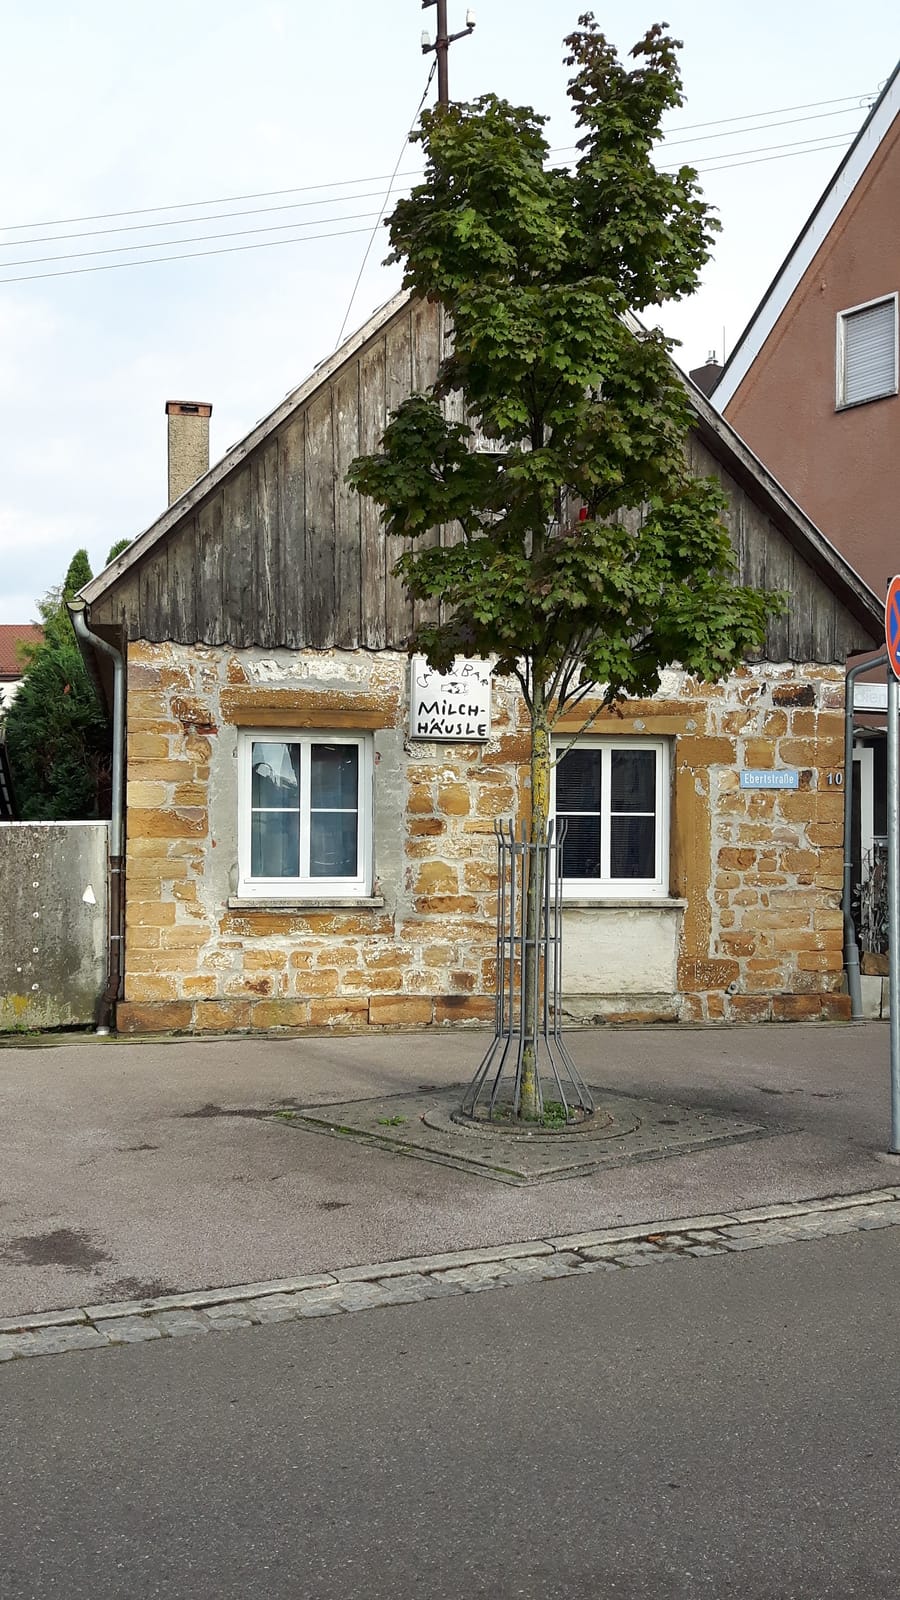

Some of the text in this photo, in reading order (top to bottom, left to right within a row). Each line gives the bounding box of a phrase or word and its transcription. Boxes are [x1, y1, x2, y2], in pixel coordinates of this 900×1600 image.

[417, 718, 487, 736] HÄUSLE
[744, 773, 794, 784] Ebertstraße
[826, 772, 843, 785] 10
